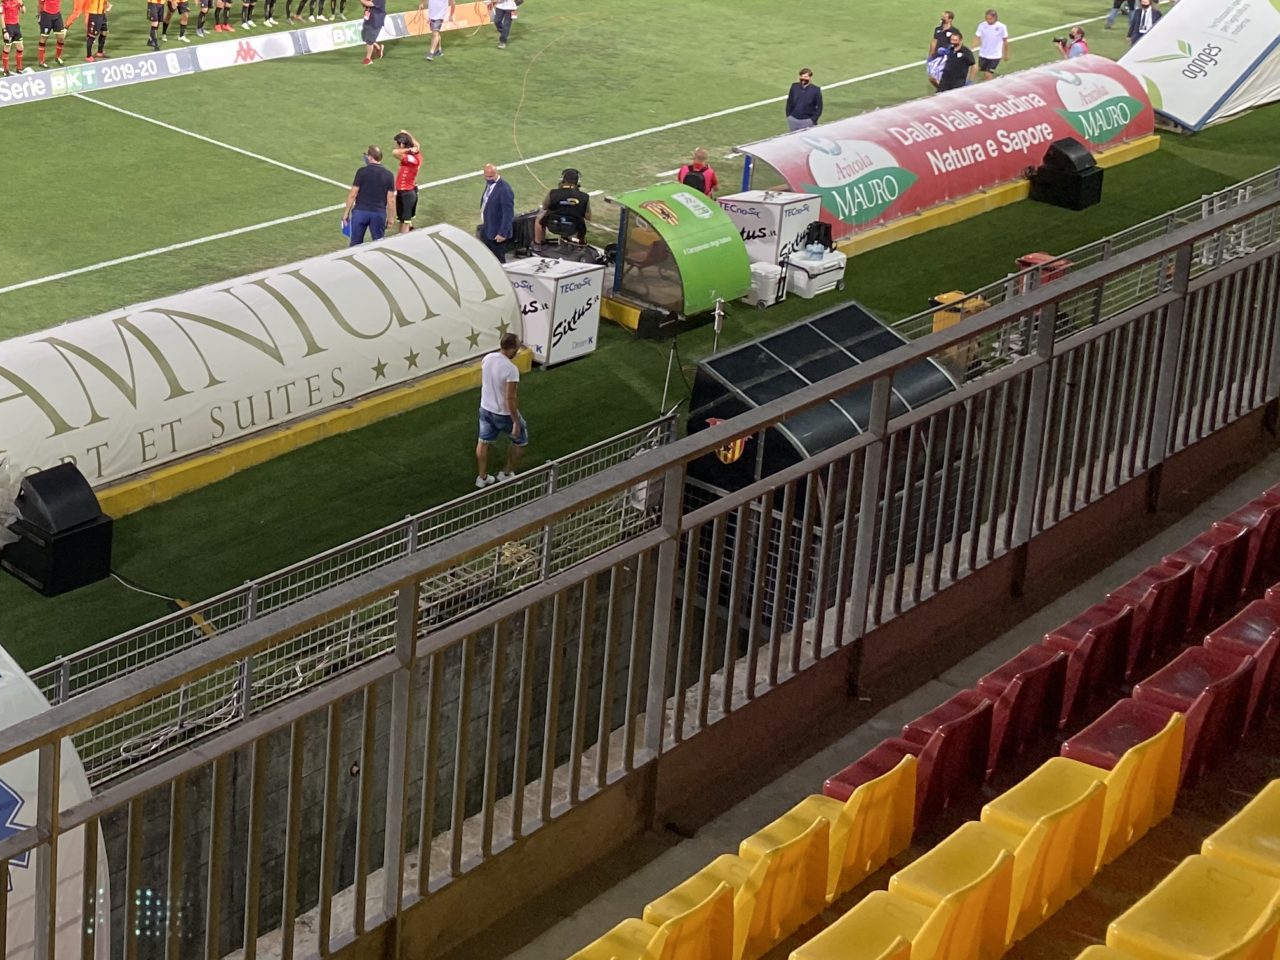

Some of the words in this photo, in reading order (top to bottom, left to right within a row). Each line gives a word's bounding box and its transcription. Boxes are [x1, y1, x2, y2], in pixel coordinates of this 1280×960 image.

[51, 69, 97, 93] BKT
[102, 60, 158, 83] 2019-20
[888, 116, 944, 146] Dalla
[934, 108, 983, 134] Valle
[983, 91, 1047, 121] Caudina
[1078, 102, 1131, 141] MAURO
[926, 144, 986, 176] Natura
[986, 139, 999, 158] e
[996, 122, 1054, 154] Sapore
[832, 175, 899, 221] MAURO
[140, 418, 182, 466] ET
[210, 366, 347, 440] SUITES
